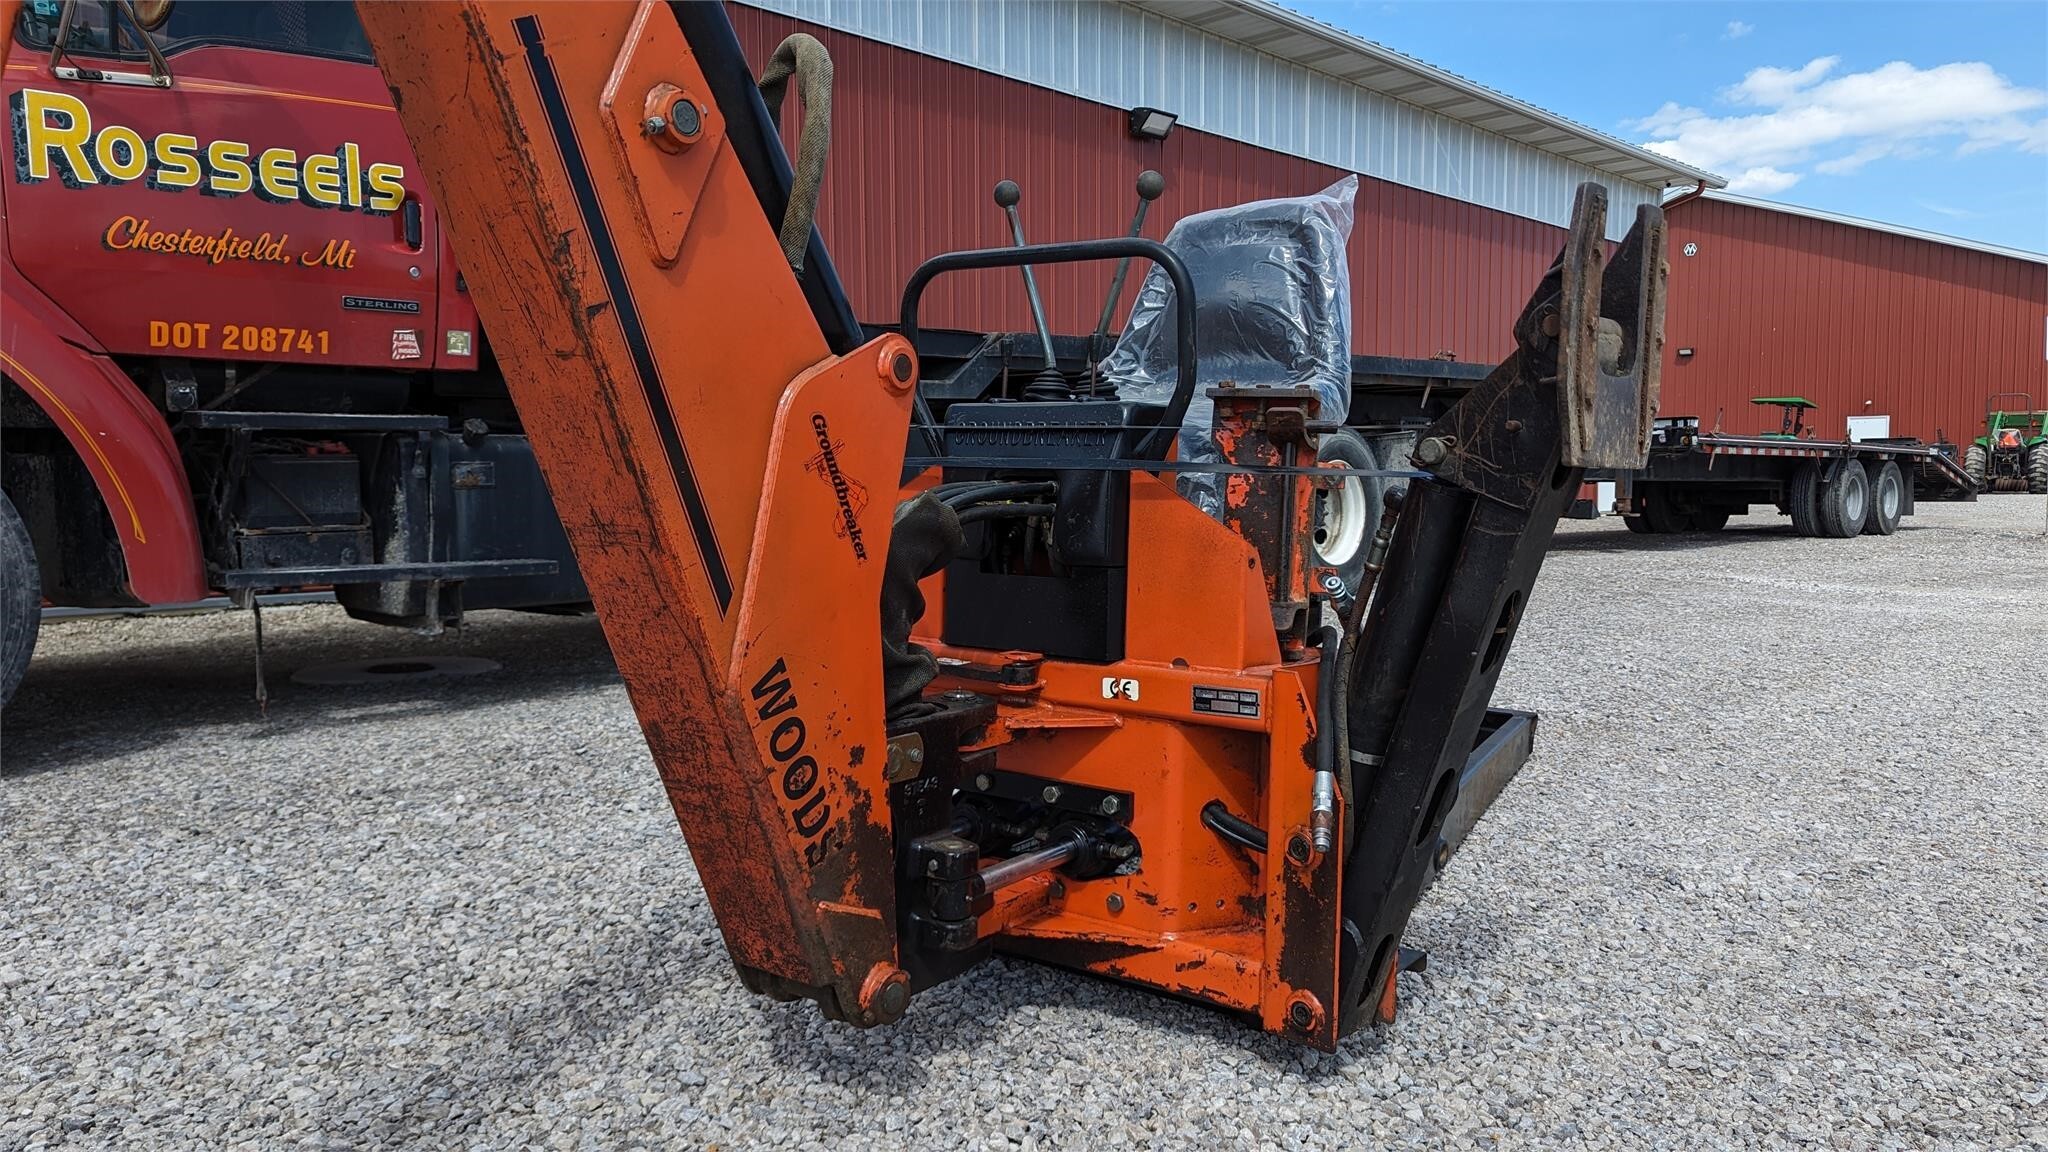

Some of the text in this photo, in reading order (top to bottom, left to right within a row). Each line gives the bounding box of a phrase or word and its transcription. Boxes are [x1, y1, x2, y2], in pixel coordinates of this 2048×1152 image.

[22, 88, 405, 212] Rosseels
[106, 215, 357, 268] Chesterfield, Mi
[346, 298, 418, 311] STERLING
[150, 320, 329, 354] DOT 208741
[955, 421, 1108, 447] GROUNDBREAKER
[811, 414, 868, 561] Groundbreaker
